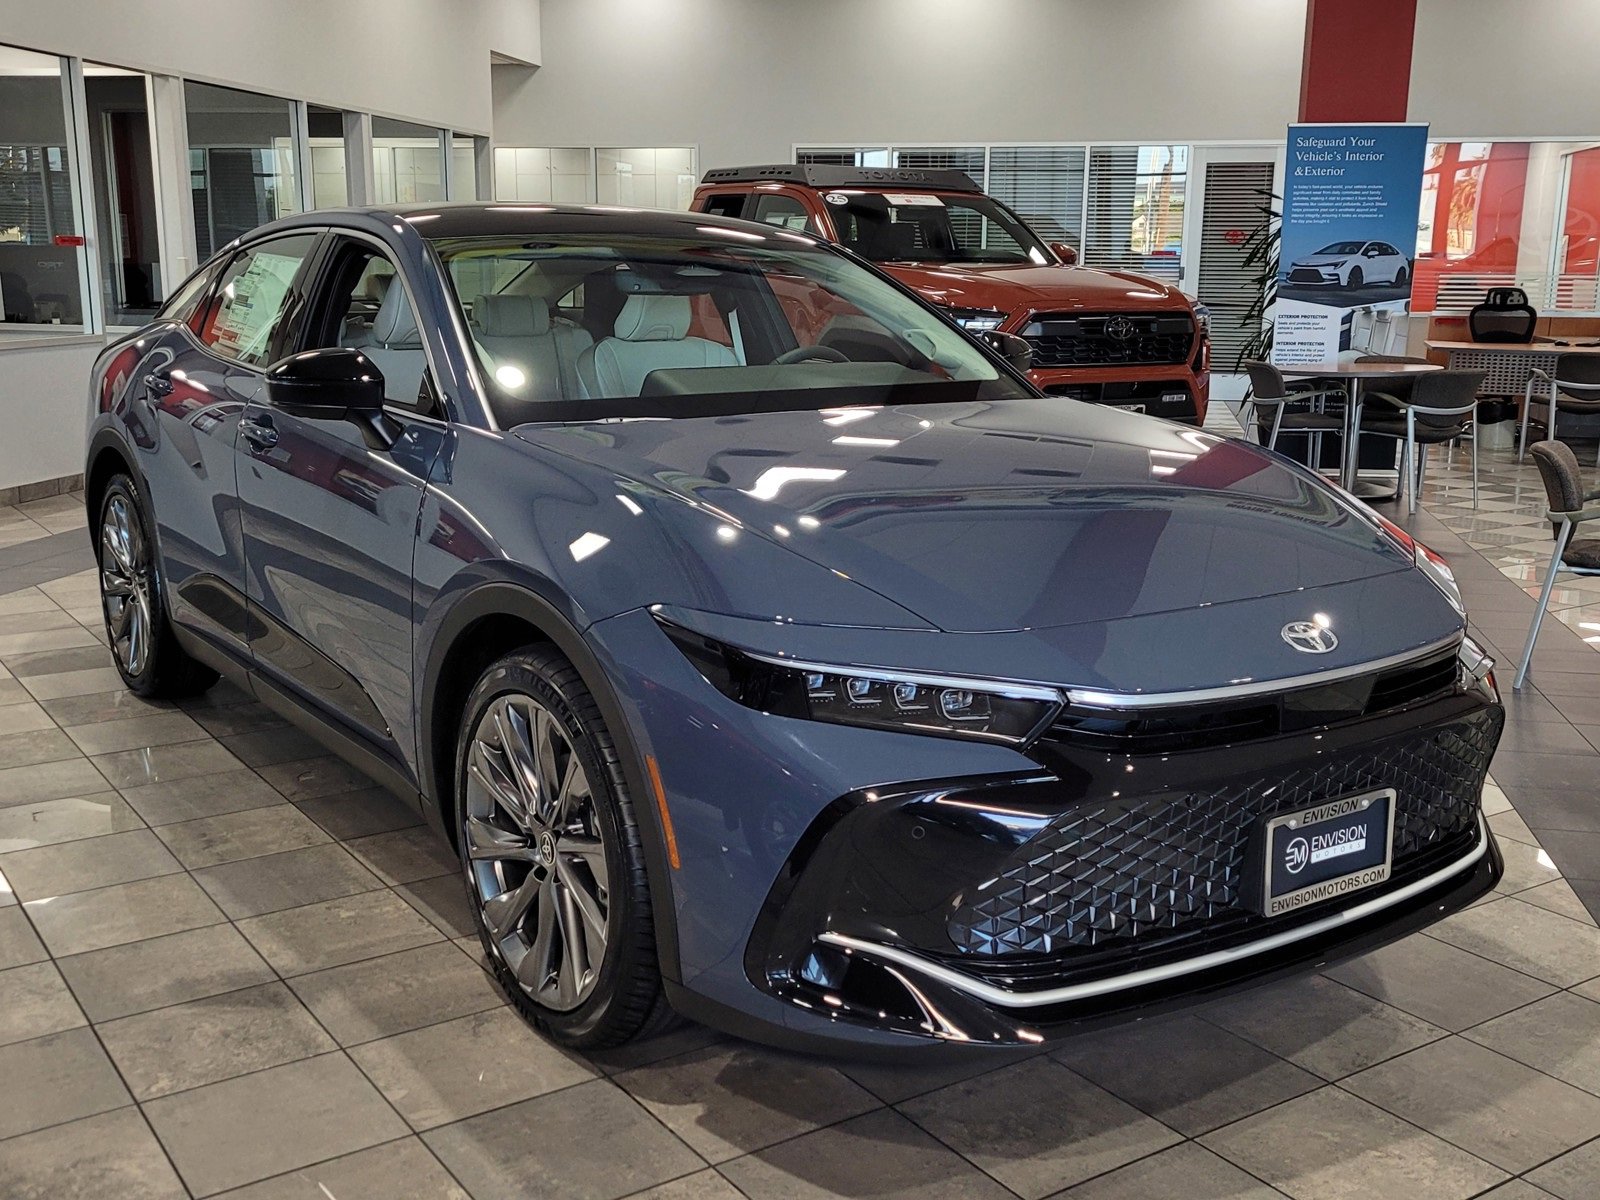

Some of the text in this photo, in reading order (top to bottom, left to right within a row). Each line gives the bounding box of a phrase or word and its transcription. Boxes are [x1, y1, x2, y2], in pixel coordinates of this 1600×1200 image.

[1296, 137, 1376, 148] Safeguard Your
[1296, 151, 1385, 161] Vehicle's Interior
[859, 171, 934, 182] TOYOTA
[828, 195, 847, 204] 25
[1302, 799, 1359, 825] ENVISION
[1311, 823, 1367, 851] ENVISION
[1315, 841, 1362, 859] MOTORS
[1271, 868, 1385, 913] ENVISIONMOTORS.COM
